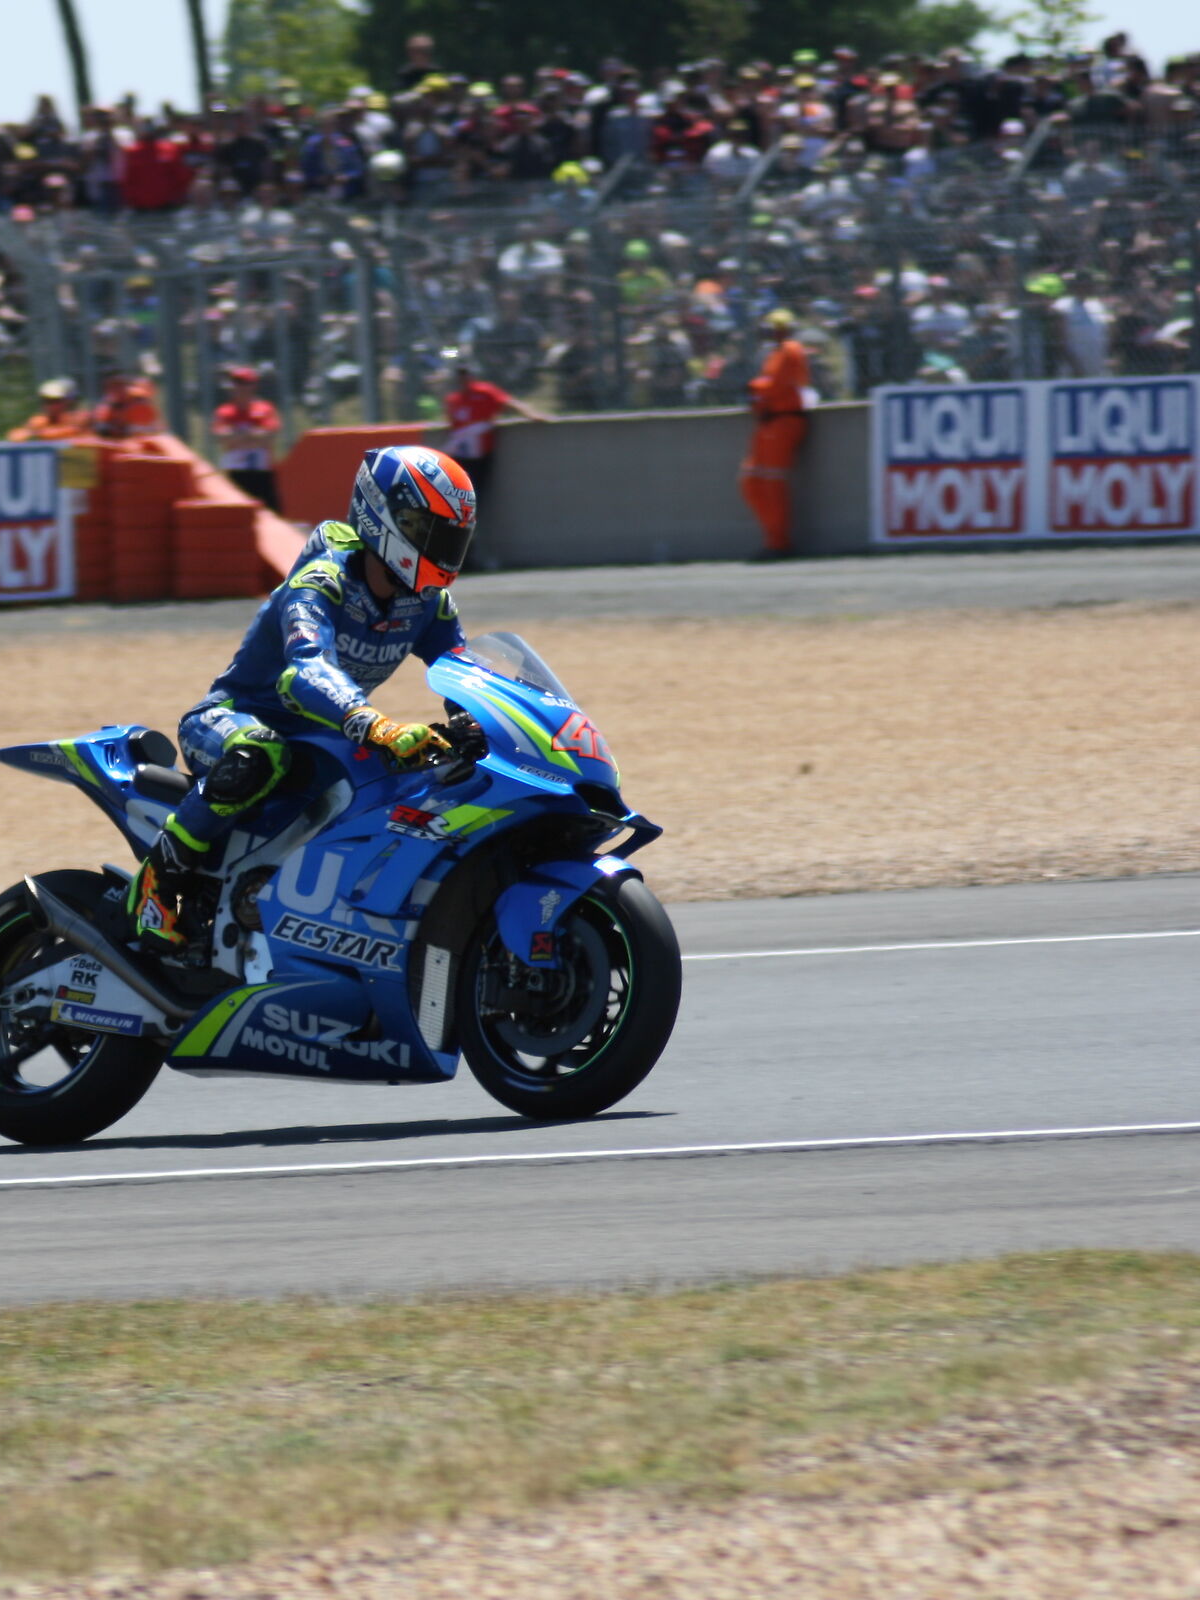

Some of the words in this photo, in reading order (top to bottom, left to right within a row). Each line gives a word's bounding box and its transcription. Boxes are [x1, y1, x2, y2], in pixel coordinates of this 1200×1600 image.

[890, 394, 1018, 459] LIQUI
[1055, 387, 1189, 456] LIQUI
[889, 465, 1025, 531] MOLY
[1055, 461, 1193, 528] MOLY
[335, 633, 413, 664] SUZUKI
[78, 958, 102, 972] Beta
[270, 911, 403, 973] ECSTAR
[71, 970, 99, 986] RK
[74, 1010, 135, 1029] MICHELIN
[242, 1026, 331, 1071] MOTUL
[262, 1002, 411, 1069] SUZUKI
